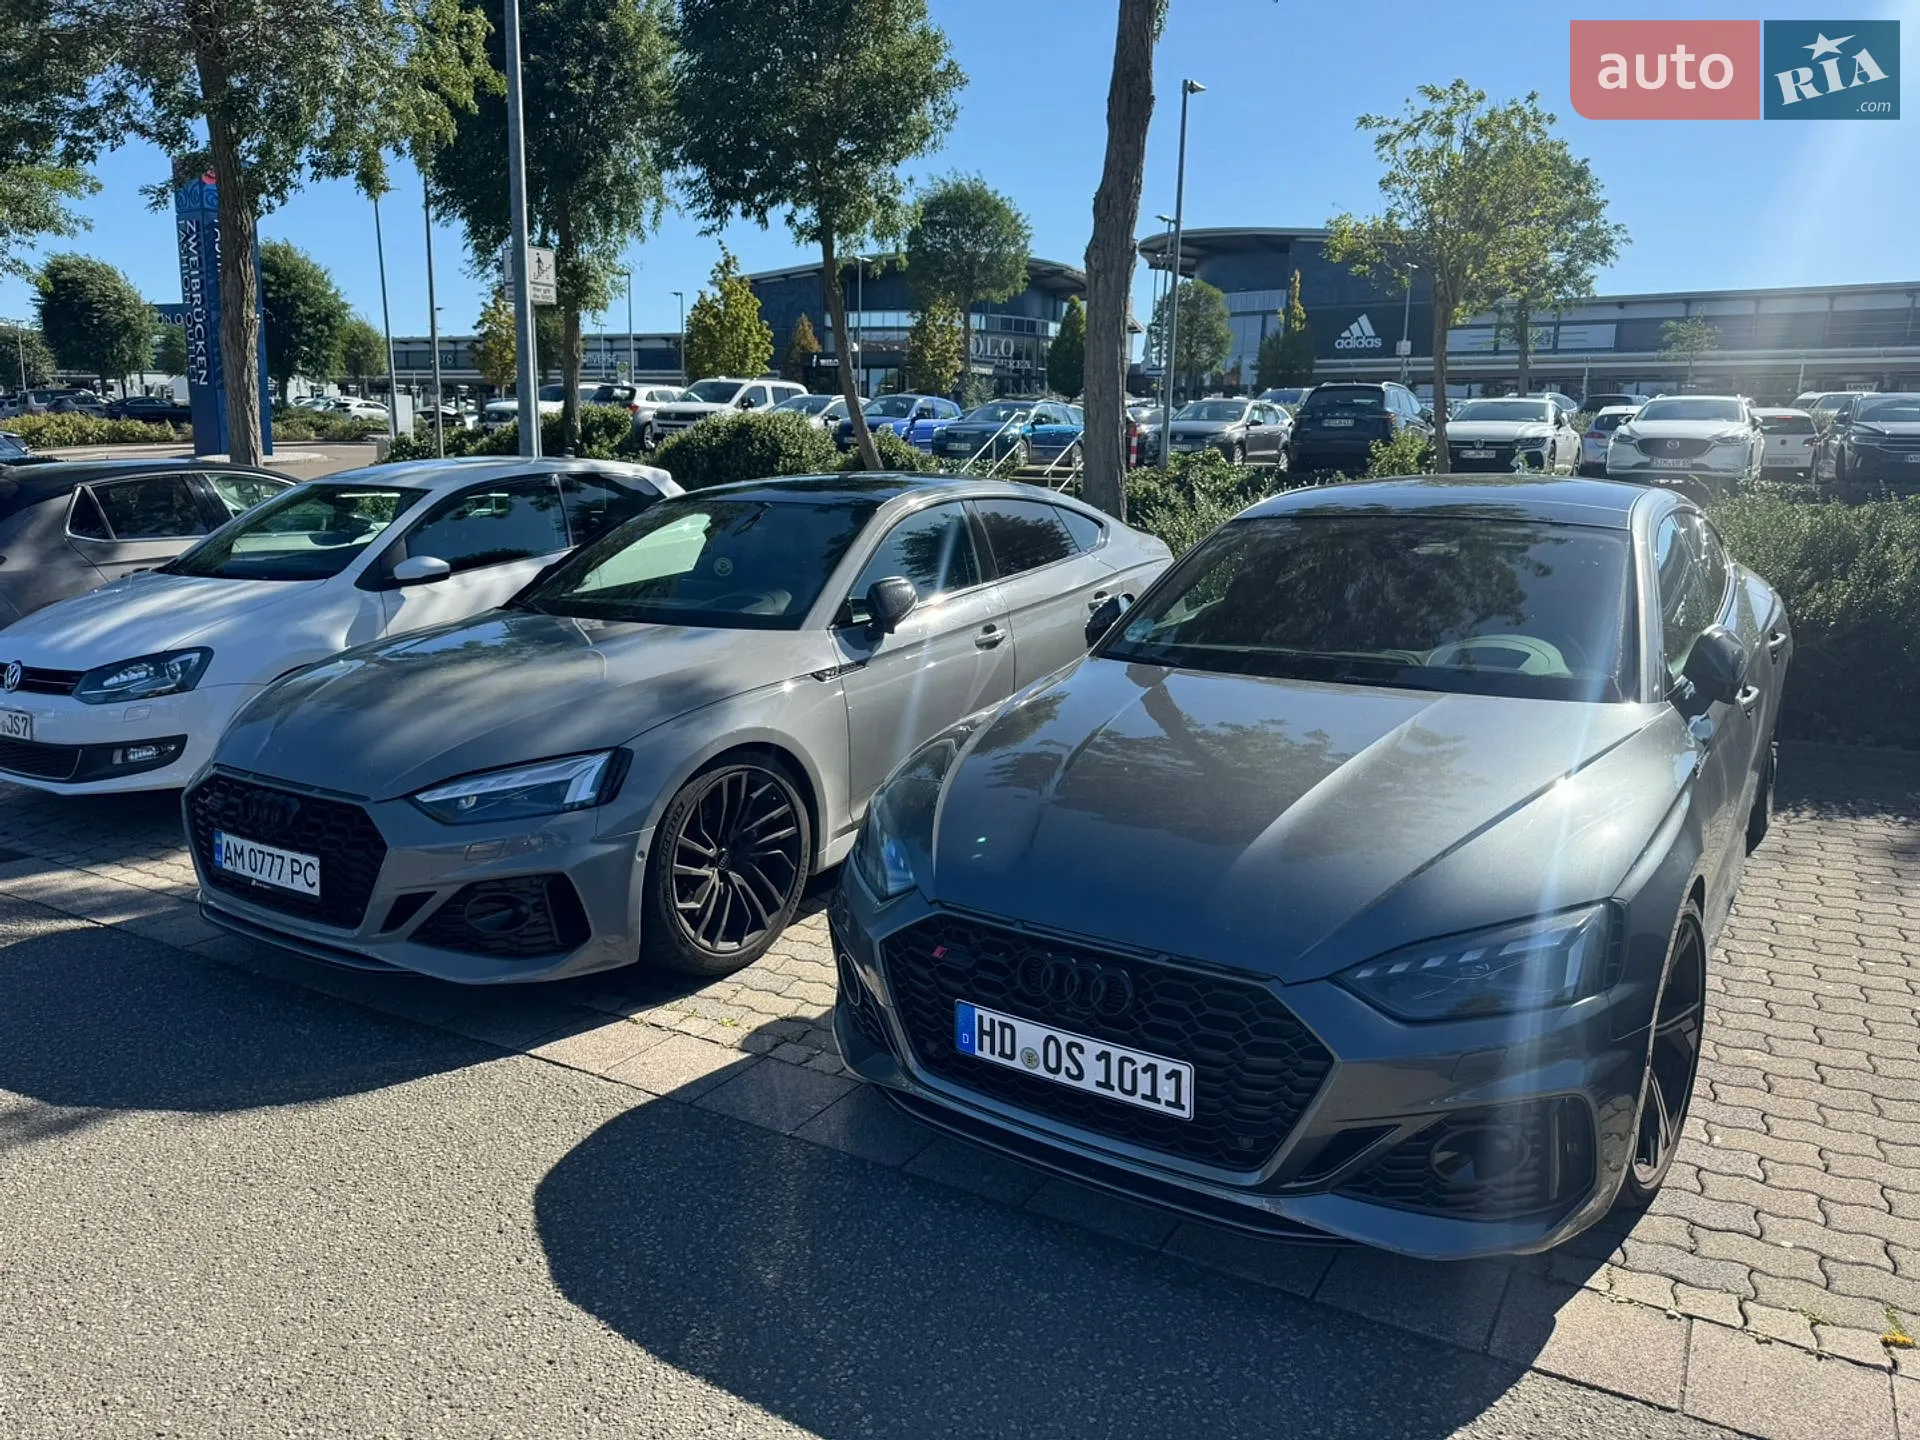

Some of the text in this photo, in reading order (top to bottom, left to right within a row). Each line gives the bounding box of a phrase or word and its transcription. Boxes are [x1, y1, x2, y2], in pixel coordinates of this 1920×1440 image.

[178, 219, 198, 385] FASHION OUTLET
[186, 219, 208, 386] ZWEIBRÜCKEN
[970, 336, 1015, 357] OLO
[1334, 335, 1383, 350] adidas
[224, 840, 316, 888] AM 0777 PC
[962, 1033, 969, 1044] D
[977, 1014, 1186, 1111] HD OS 1011
